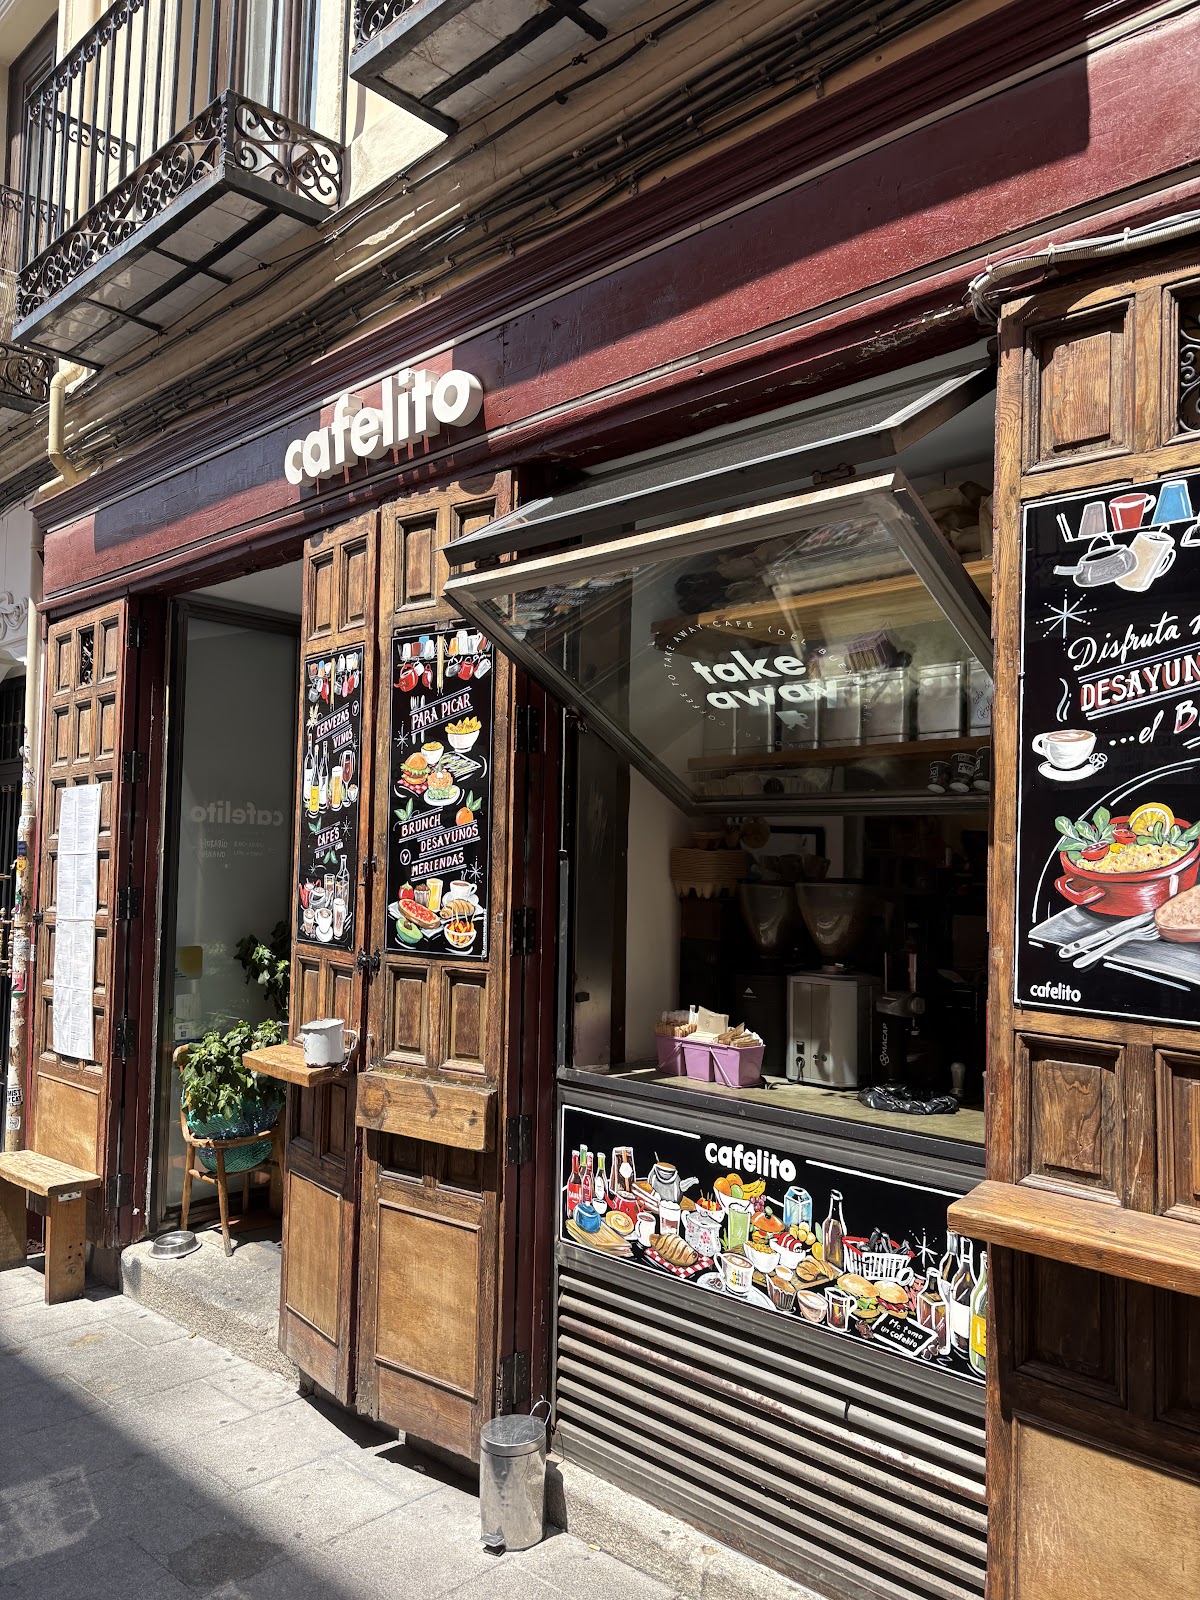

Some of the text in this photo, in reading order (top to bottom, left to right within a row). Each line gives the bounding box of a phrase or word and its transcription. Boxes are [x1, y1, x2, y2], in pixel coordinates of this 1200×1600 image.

[284, 366, 482, 484] cafelito
[664, 644, 675, 668] TAKE
[673, 624, 703, 643] AWAY
[1067, 612, 1181, 671] Disfruta
[691, 650, 807, 684] take
[706, 681, 837, 709] away
[316, 708, 350, 738] CERVEZAS
[411, 693, 471, 730] PARA PICAR
[1174, 699, 1200, 734] B
[333, 728, 353, 748] VINOS
[401, 813, 441, 837] BRUNCH
[420, 824, 479, 852] DESAYUNOS
[411, 852, 464, 877] MERIENDAS
[1030, 981, 1081, 1002] cafelito
[705, 1141, 796, 1182] cafelito
[880, 1326, 918, 1348] un cafelito
[903, 1326, 923, 1340] tomo
